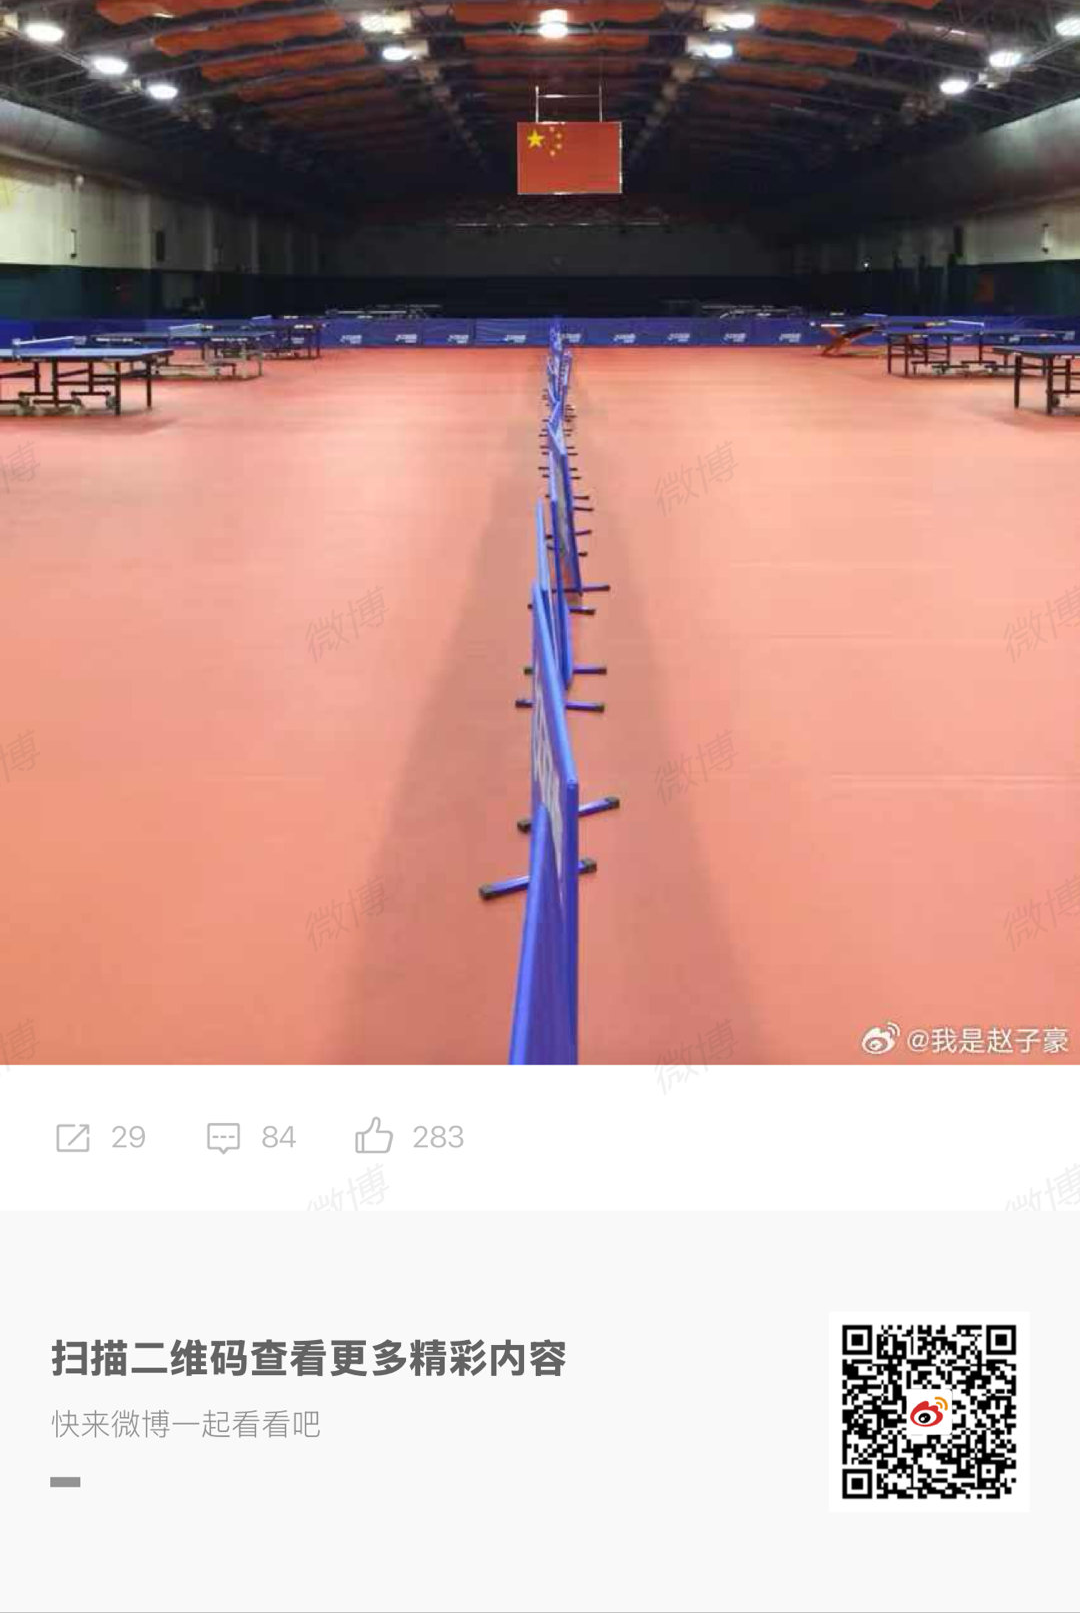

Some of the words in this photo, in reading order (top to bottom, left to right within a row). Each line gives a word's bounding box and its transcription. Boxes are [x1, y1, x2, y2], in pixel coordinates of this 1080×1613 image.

[112, 1126, 145, 1148] 29
[262, 1126, 296, 1148] 84
[414, 1126, 463, 1148] 283
[52, 1339, 565, 1376] 扫描二维码查看更多精彩内容
[52, 1410, 320, 1438] 快来微博一起看看吧
